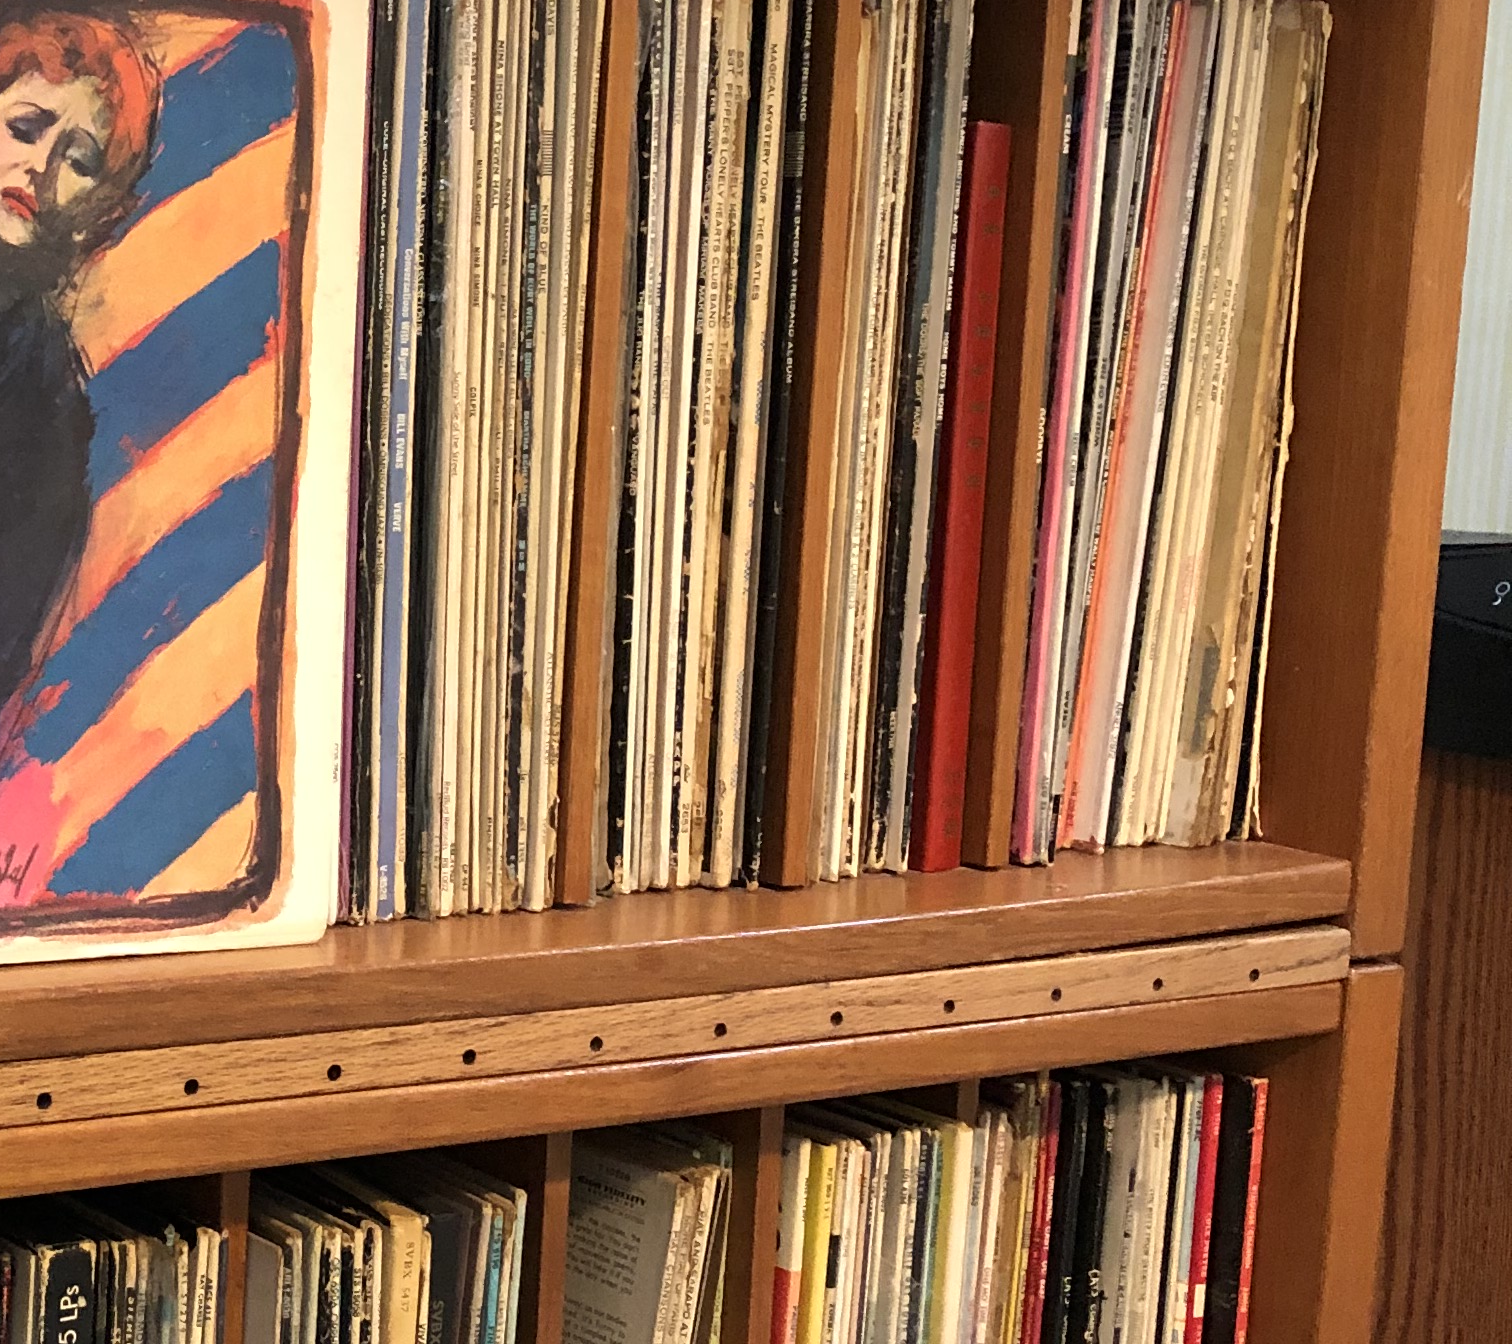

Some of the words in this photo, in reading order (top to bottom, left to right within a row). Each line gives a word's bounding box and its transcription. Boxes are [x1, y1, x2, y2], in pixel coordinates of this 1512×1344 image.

[496, 40, 505, 69] NINA
[766, 44, 778, 100] MAGICAL
[495, 74, 504, 115] SIMONE
[494, 122, 502, 135] AT
[721, 83, 732, 144] PEPPER'S
[762, 105, 774, 165] MYSTERY
[1062, 114, 1072, 154] CREAM
[492, 140, 501, 175] TOWN
[716, 149, 728, 198] LONELY
[490, 180, 500, 208] HALL
[759, 170, 769, 204] TOUR
[540, 206, 550, 234] KIND
[712, 202, 725, 252] HEARTS
[756, 216, 766, 240] THE
[540, 241, 548, 256] OF
[948, 238, 957, 273] TOMMY
[400, 248, 414, 317] Conversations
[538, 264, 547, 294] BLUE
[710, 257, 720, 290] CLUB
[752, 244, 762, 300] BEATLES
[708, 288, 718, 328] BAND
[400, 321, 410, 344] With
[397, 348, 408, 380] Myself
[706, 342, 715, 364] THE
[702, 369, 712, 426] BEATLES
[396, 414, 406, 434] BILL
[394, 438, 404, 468] EVANS
[392, 502, 402, 532] VERVE
[402, 1242, 415, 1279] SVBX
[691, 1240, 703, 1266] AND
[59, 1284, 80, 1322] LPs
[58, 1330, 76, 1344] 5
[680, 1322, 690, 1338] AT
